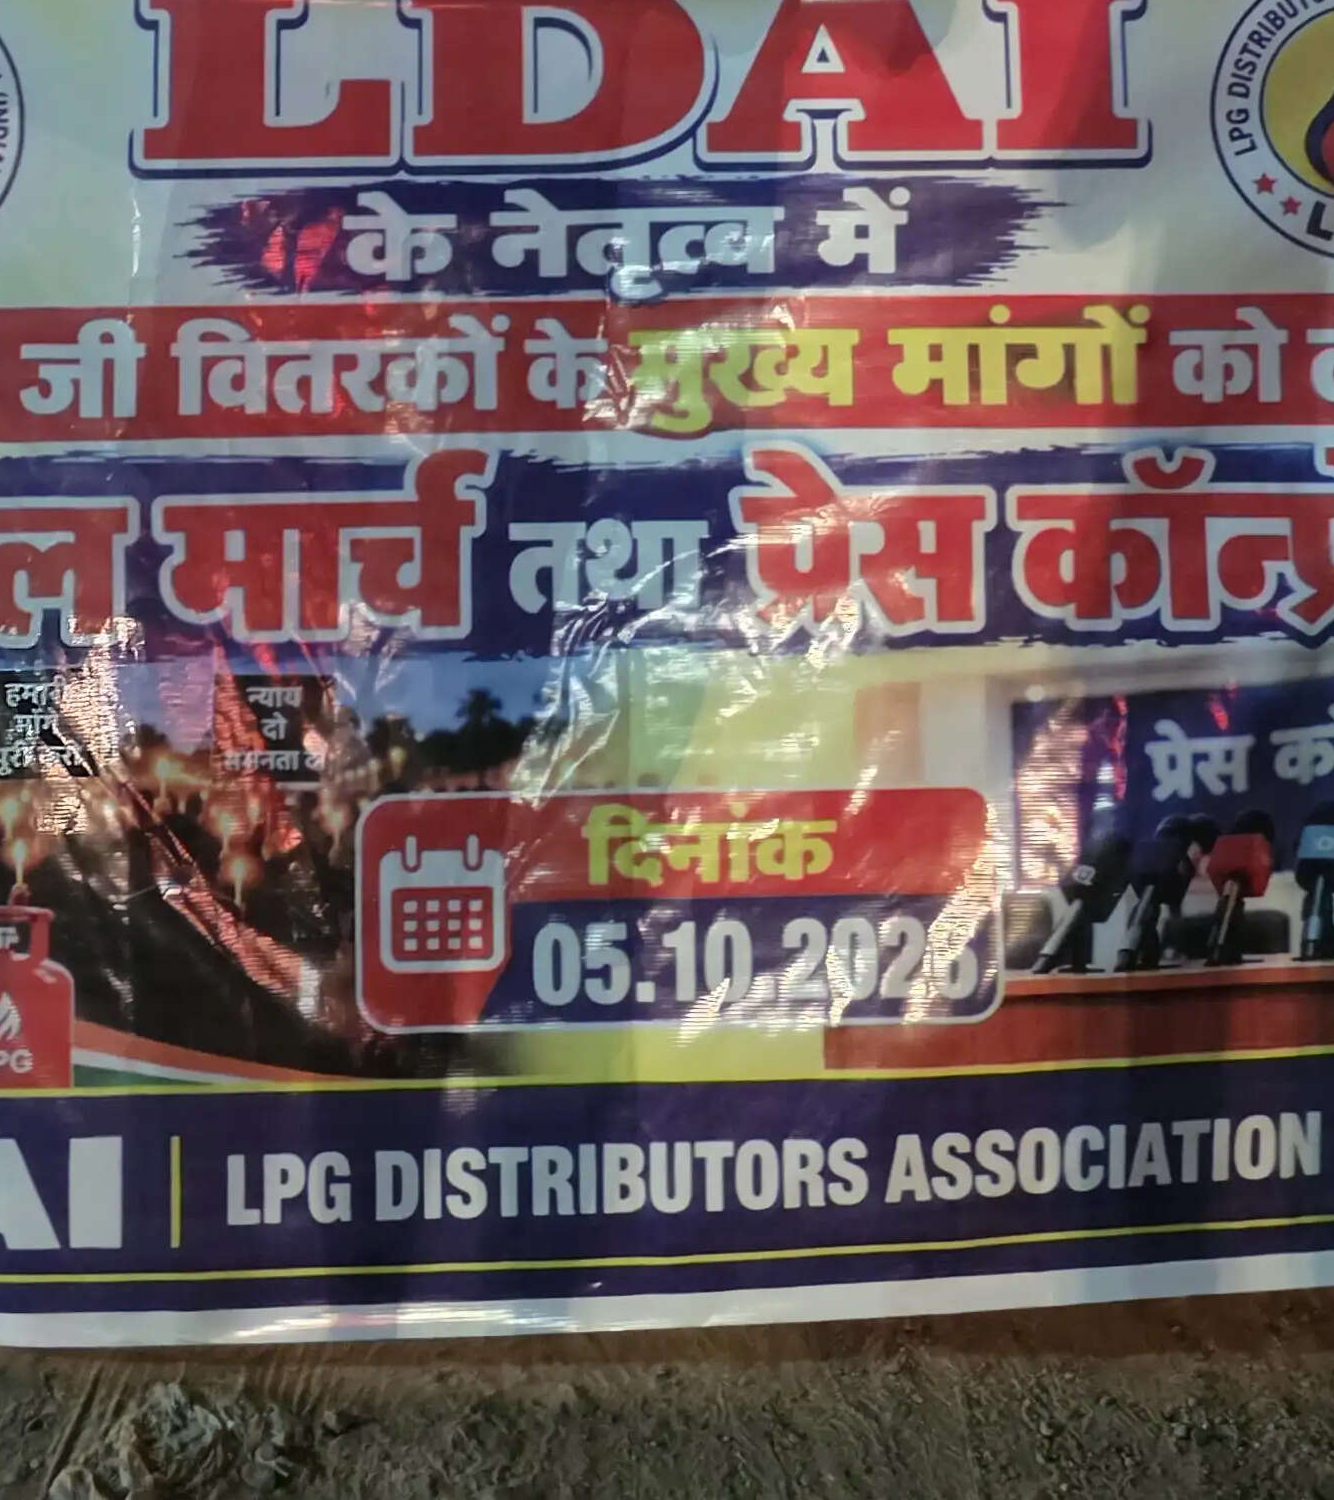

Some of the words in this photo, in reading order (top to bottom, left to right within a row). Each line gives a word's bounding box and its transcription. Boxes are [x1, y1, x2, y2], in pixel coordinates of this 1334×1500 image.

[1226, 111, 1258, 157] LPG
[342, 190, 457, 282] के
[490, 188, 785, 300] नेतृत्व
[815, 186, 911, 275] में
[19, 319, 146, 421] जी
[170, 315, 505, 418] वितरकों
[525, 317, 608, 411] के
[628, 327, 859, 435] मुख्य
[887, 304, 1151, 406] मांगों
[1169, 306, 1288, 403] को
[157, 444, 493, 638] मार्च
[508, 518, 709, 616] तथा
[735, 445, 991, 635] प्रेस
[246, 686, 302, 708] न्याय
[262, 712, 287, 740] दो
[1144, 713, 1254, 800] प्रेस
[582, 803, 837, 886] दिनांक
[226, 1150, 352, 1227] LPG
[374, 1136, 868, 1223] DISTRIBUTORS
[884, 1109, 1322, 1202] ASSOCIATION
